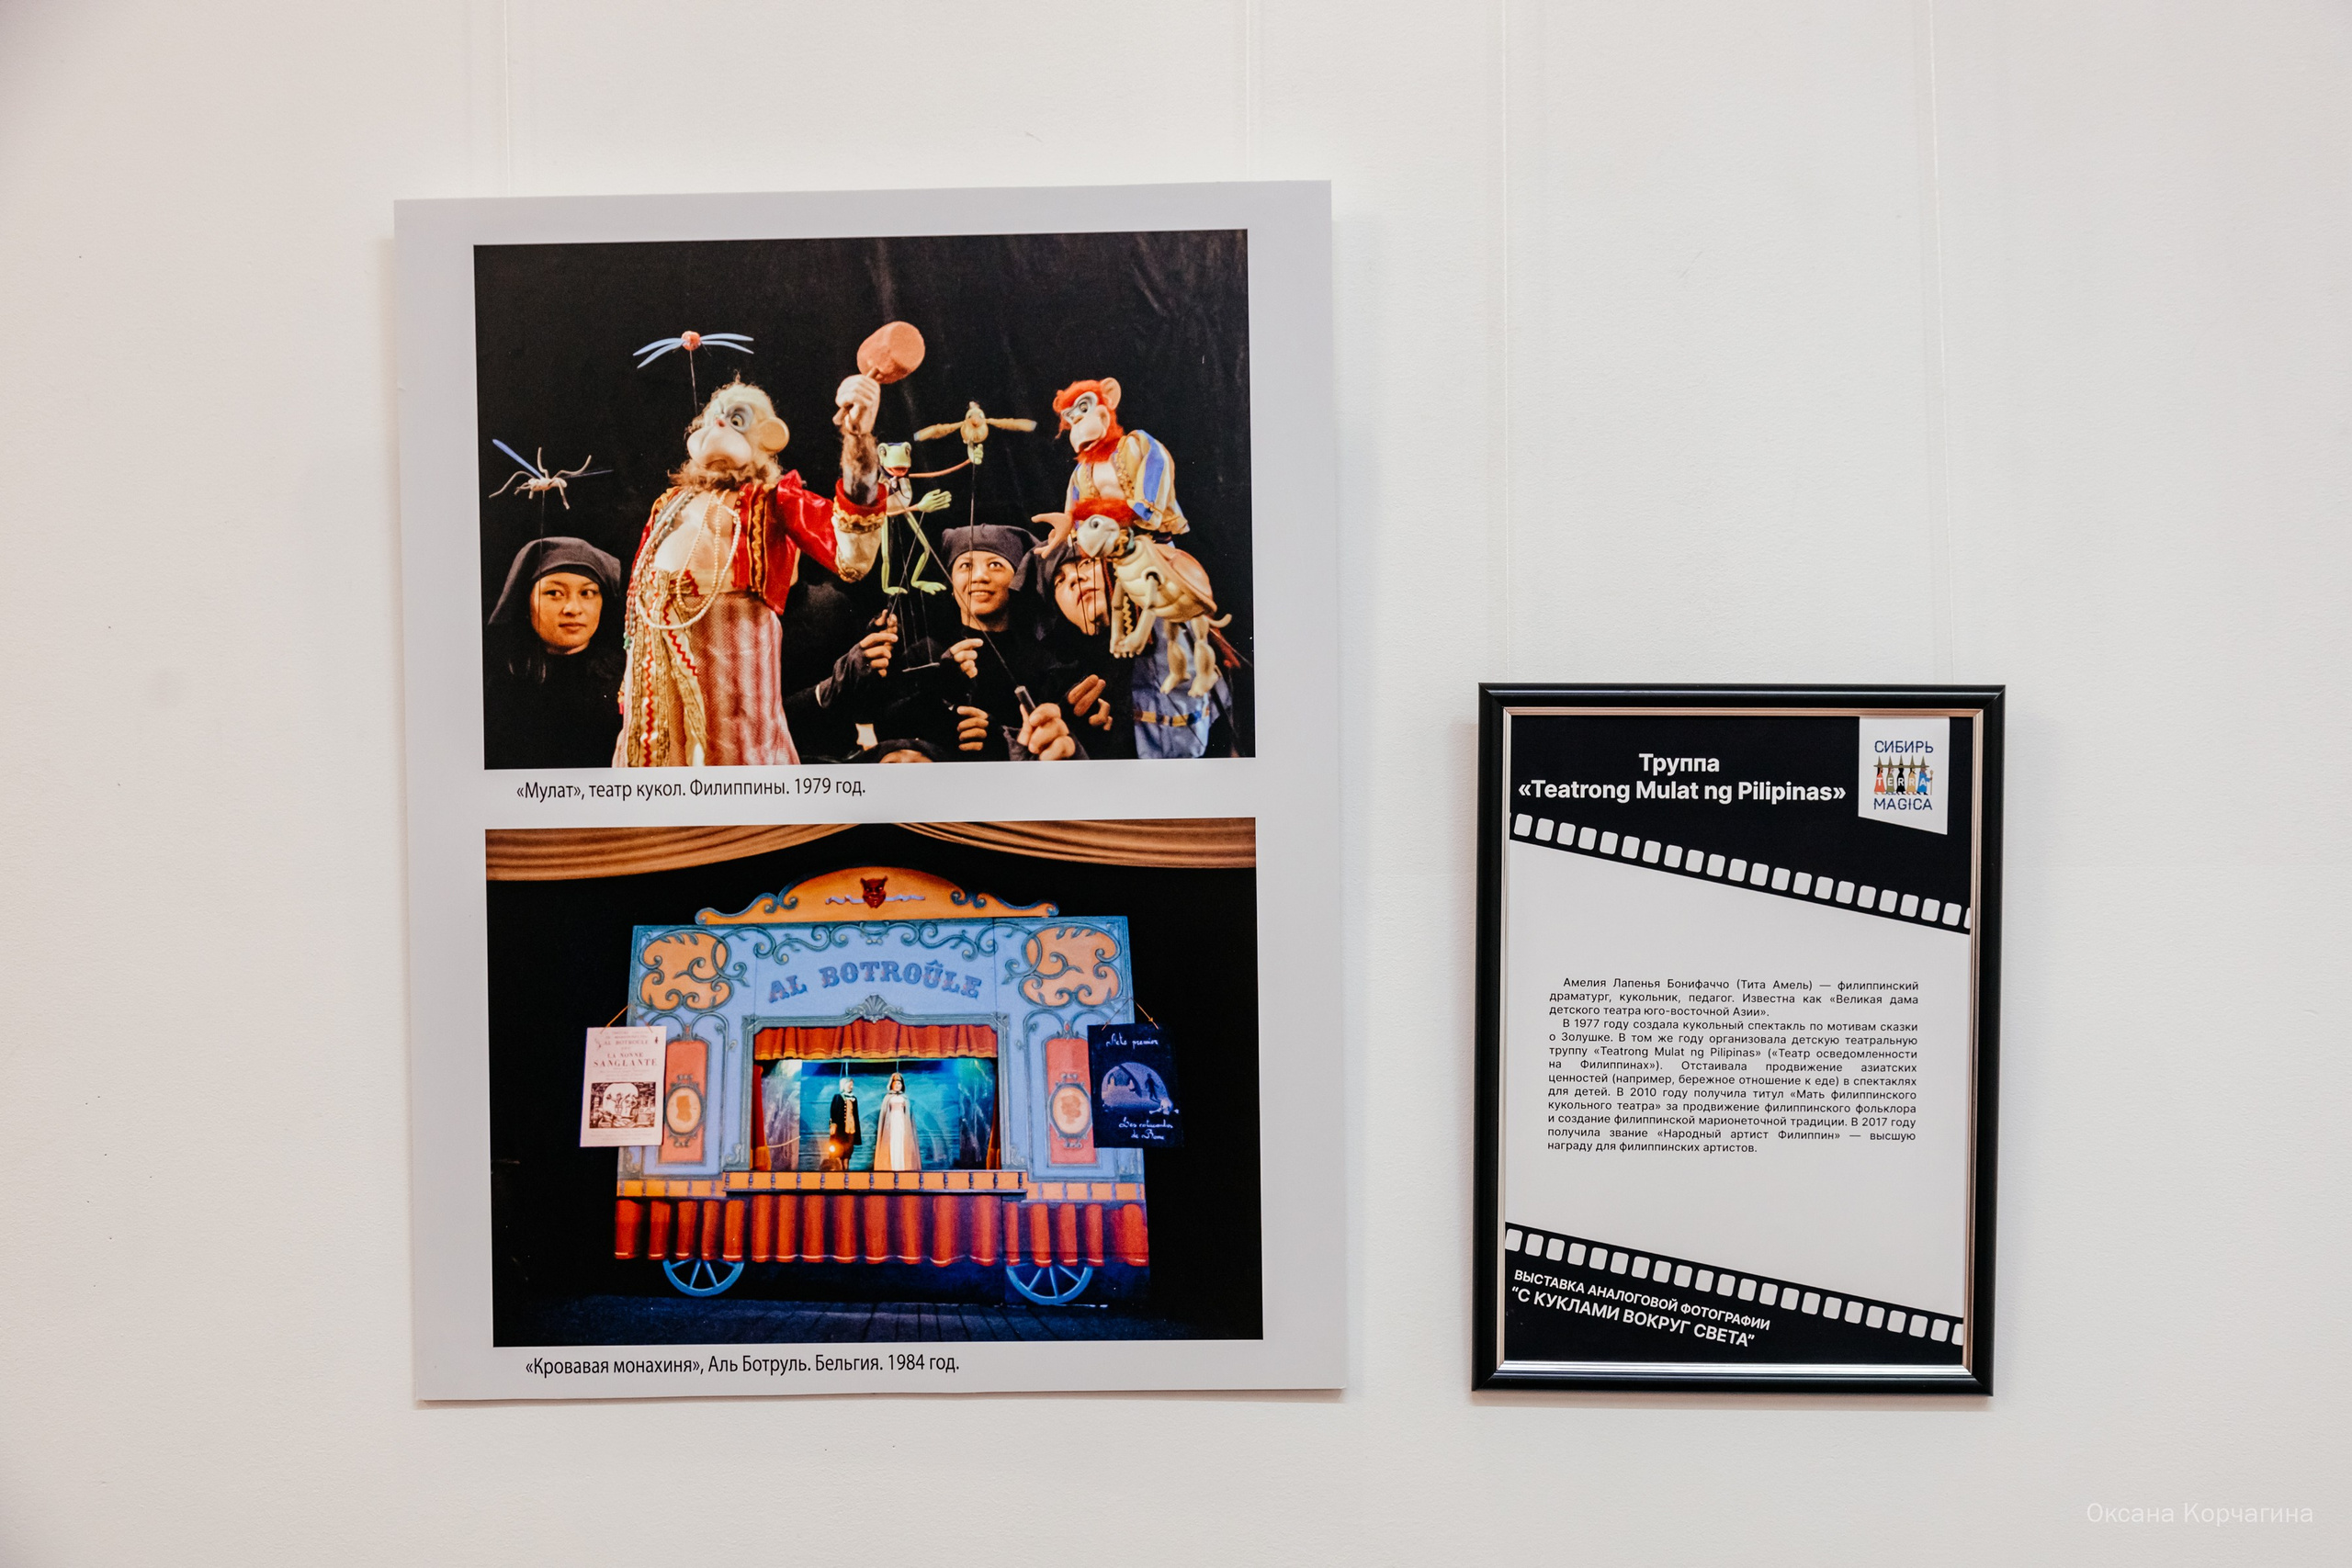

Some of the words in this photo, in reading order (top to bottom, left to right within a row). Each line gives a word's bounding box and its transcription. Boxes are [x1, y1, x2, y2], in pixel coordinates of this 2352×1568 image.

[1874, 740, 1934, 753] СИБИРЬ
[1638, 752, 1720, 776] Труппа
[1876, 777, 1927, 787] TERRA
[516, 781, 585, 804] «Мулат»,
[588, 784, 632, 802] театр
[637, 784, 686, 802] кукол.
[689, 778, 790, 796] Филиппины.
[795, 777, 831, 795] 1979
[835, 780, 866, 797] год.
[1518, 779, 1631, 804] «Teatrong
[1635, 780, 1700, 800] Mulat
[1703, 784, 1733, 805] ng
[1737, 780, 1847, 806] Pilipinas»
[1874, 797, 1933, 810] MAGICA
[769, 976, 808, 1003] AL
[819, 960, 982, 999] BOTROÛLE
[1563, 977, 1607, 987] Амелия
[1612, 977, 1660, 988] Лапенья
[1667, 978, 1730, 991] Бонифаччо
[1736, 978, 1766, 990] (Тита
[1772, 979, 1813, 991] Амель)
[1837, 980, 1919, 992] филиппинский
[1549, 992, 1612, 1003] драматург,
[1619, 994, 1681, 1004] кукольник,
[1689, 994, 1735, 1004] педагог.
[1742, 993, 1795, 1004] Известна
[1803, 996, 1822, 1004] как
[1829, 994, 1883, 1004] «Великая
[1889, 996, 1918, 1006] дама
[1548, 1006, 1600, 1016] детского
[1602, 1007, 1642, 1018] театра
[1644, 1007, 1730, 1017] юго-восточной
[1732, 1007, 1770, 1017] Азии».
[1562, 1018, 1570, 1028] В
[1574, 1018, 1600, 1029] 1977
[1603, 1021, 1630, 1032] году
[1633, 1021, 1679, 1031] создала
[1682, 1021, 1744, 1032] кукольный
[1747, 1022, 1806, 1031] спектакль
[1809, 1022, 1824, 1032] по
[1826, 1023, 1876, 1032] мотивам
[1880, 1023, 1918, 1032] сказки
[1548, 1033, 1556, 1042] о
[1561, 1032, 1613, 1044] Золушке.
[1618, 1032, 1626, 1043] В
[1631, 1034, 1653, 1043] том
[1657, 1034, 1674, 1043] же
[1679, 1035, 1704, 1045] году
[1709, 1035, 1787, 1045] организовала
[1791, 1036, 1840, 1047] детскую
[1845, 1037, 1918, 1047] театральную
[1548, 1047, 1589, 1058] труппу
[1593, 1045, 1649, 1059] «Teatrong
[1654, 1046, 1685, 1057] Mulat
[1690, 1049, 1704, 1059] ng
[1710, 1047, 1761, 1059] Pilipinas»
[1768, 1047, 1811, 1060] («Театр
[1815, 1050, 1917, 1060] осведомленности
[594, 1058, 657, 1067] SANGLANTE
[1548, 1061, 1562, 1069] на
[1579, 1059, 1663, 1072] Филиппинах»).
[1680, 1060, 1747, 1071] Отстаивала
[1765, 1064, 1843, 1074] продвижение
[1860, 1065, 1917, 1073] азиатских
[1548, 1073, 1608, 1084] ценностей
[1611, 1073, 1675, 1086] (например,
[1678, 1074, 1736, 1087] бережное
[1738, 1077, 1802, 1086] отношение
[1804, 1077, 1812, 1086] к
[1815, 1076, 1839, 1088] еде)
[1843, 1077, 1850, 1086] в
[1853, 1077, 1917, 1087] спектаклях
[1547, 1088, 1569, 1098] для
[1574, 1087, 1611, 1098] детей.
[1616, 1087, 1624, 1097] В
[1630, 1087, 1657, 1098] 2010
[1662, 1089, 1689, 1100] году
[1693, 1089, 1747, 1100] получила
[1752, 1090, 1784, 1101] титул
[1790, 1089, 1826, 1100] «Мать
[1830, 1089, 1917, 1101] филиппинского
[1548, 1101, 1612, 1111] кукольного
[1616, 1102, 1661, 1113] театра»
[1666, 1103, 1679, 1111] за
[1682, 1103, 1760, 1113] продвижение
[1764, 1102, 1851, 1114] филиппинского
[1855, 1103, 1917, 1116] фольклора
[1557, 1115, 1611, 1125] создание
[1613, 1114, 1695, 1126] филиппинской
[1698, 1116, 1787, 1127] марионеточной
[1790, 1118, 1848, 1128] традиции.
[1850, 1117, 1859, 1127] В
[1861, 1117, 1888, 1127] 2017
[1891, 1119, 1917, 1130] году
[1547, 1128, 1600, 1139] получила
[1609, 1129, 1648, 1138] звание
[1657, 1128, 1722, 1141] «Народный
[1730, 1131, 1770, 1141] артист
[1778, 1130, 1840, 1140] Филиппин»
[1870, 1133, 1917, 1143] высшую
[1547, 1142, 1593, 1153] награду
[1595, 1143, 1616, 1153] для
[1619, 1141, 1701, 1153] филиппинских
[1702, 1144, 1758, 1155] артистов.
[1513, 1269, 1585, 1294] ВЫСТАВКА
[1587, 1284, 1679, 1313] АНАЛОГОВОЙ
[1679, 1303, 1770, 1331] ФОТОГРАФИИ
[1533, 1291, 1621, 1321] КУКЛАМИ
[1622, 1308, 1691, 1335] ВОКРУГ
[526, 1357, 609, 1379] «Кровавая
[613, 1359, 704, 1375] монахиня»,
[707, 1355, 739, 1372] Аль
[742, 1355, 811, 1377] Ботруль.
[815, 1354, 884, 1371] Бельгия.
[888, 1353, 925, 1371] 1984
[929, 1357, 960, 1374] год.
